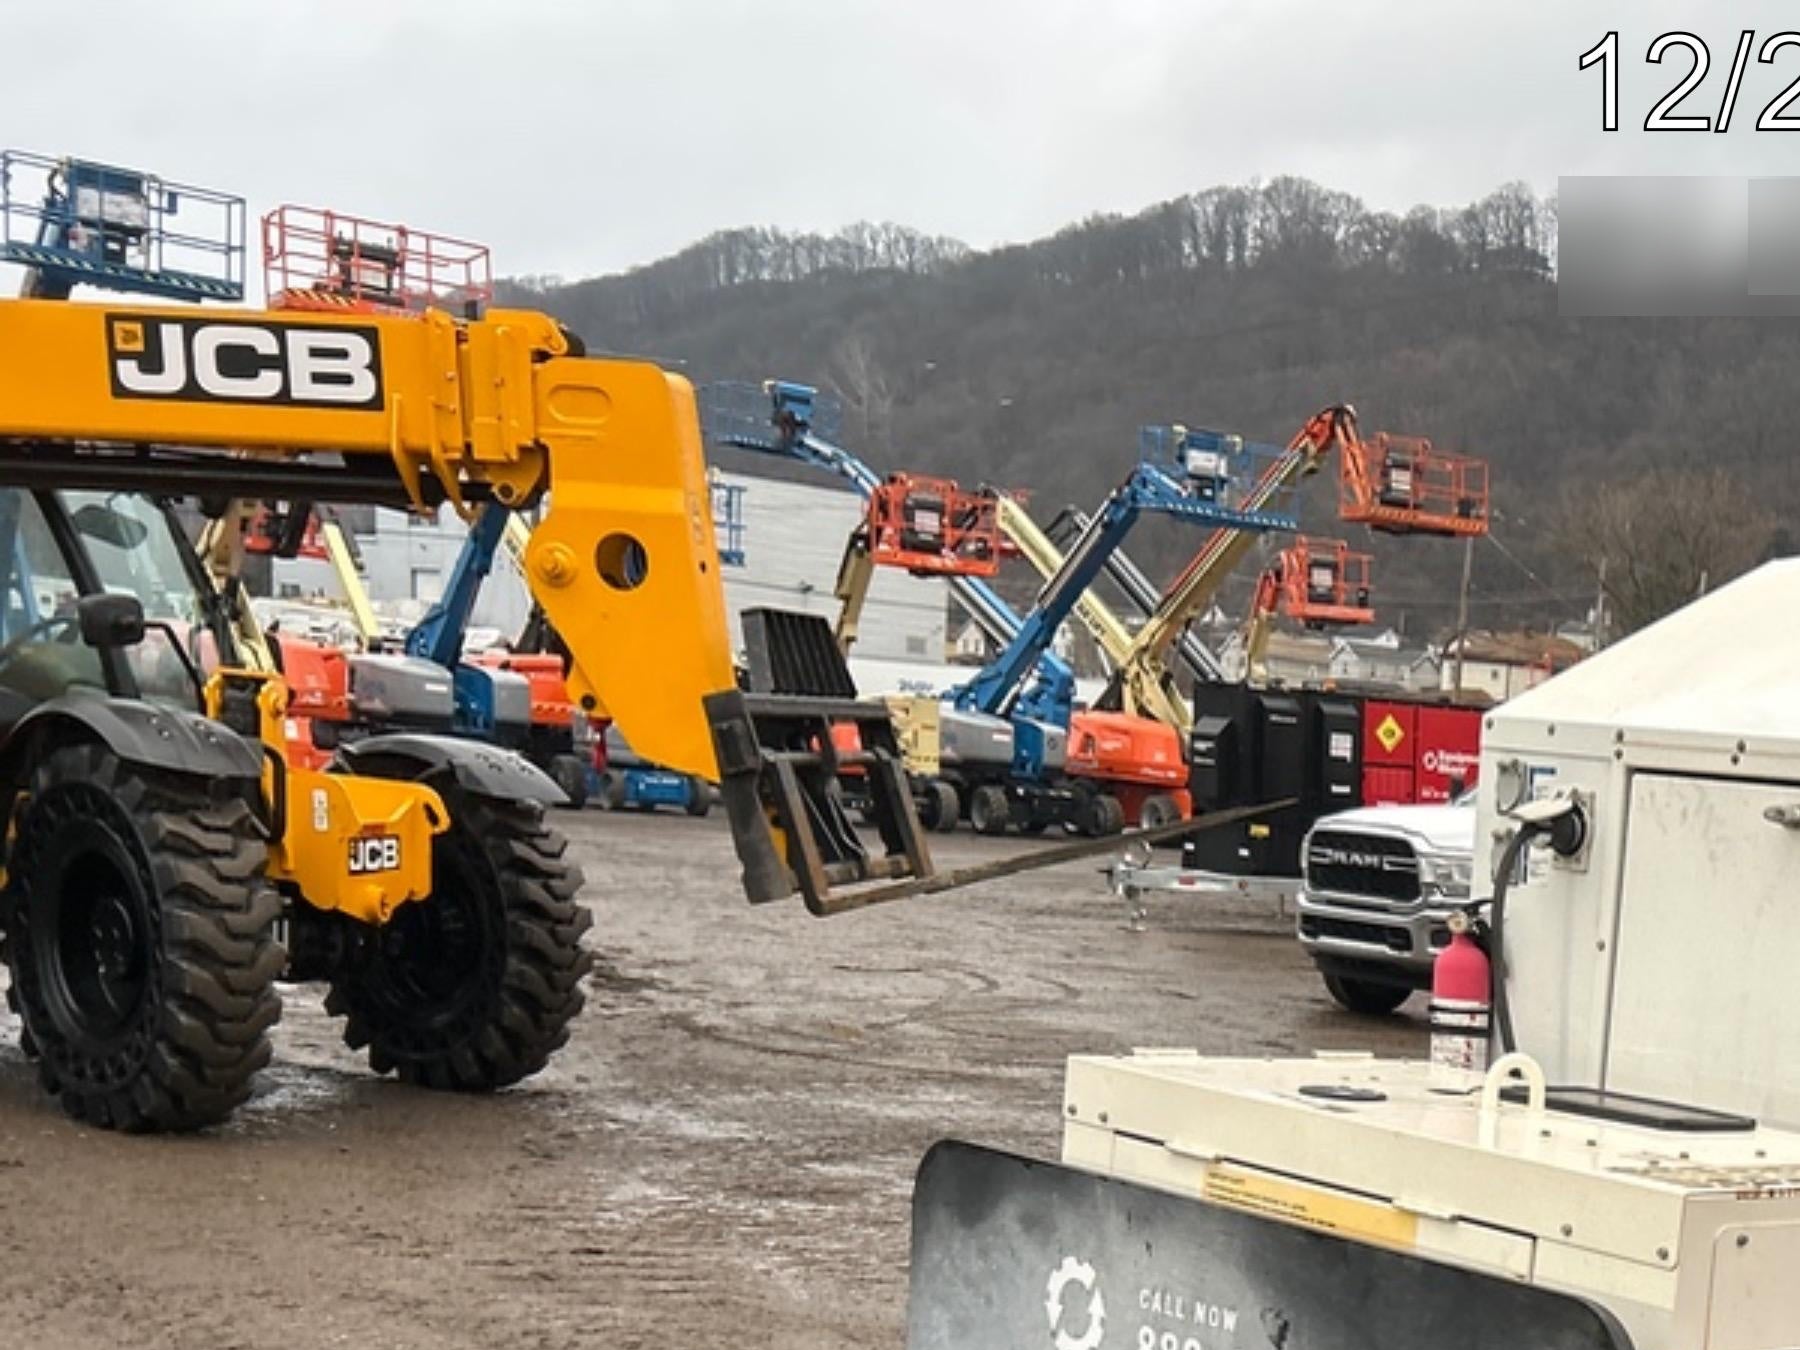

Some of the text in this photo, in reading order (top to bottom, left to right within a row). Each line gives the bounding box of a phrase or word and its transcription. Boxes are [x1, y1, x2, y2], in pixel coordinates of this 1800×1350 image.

[116, 323, 377, 403] JCB
[350, 838, 398, 872] JCB
[1332, 849, 1379, 869] RAM
[1139, 1288, 1239, 1333] CALL NOW
